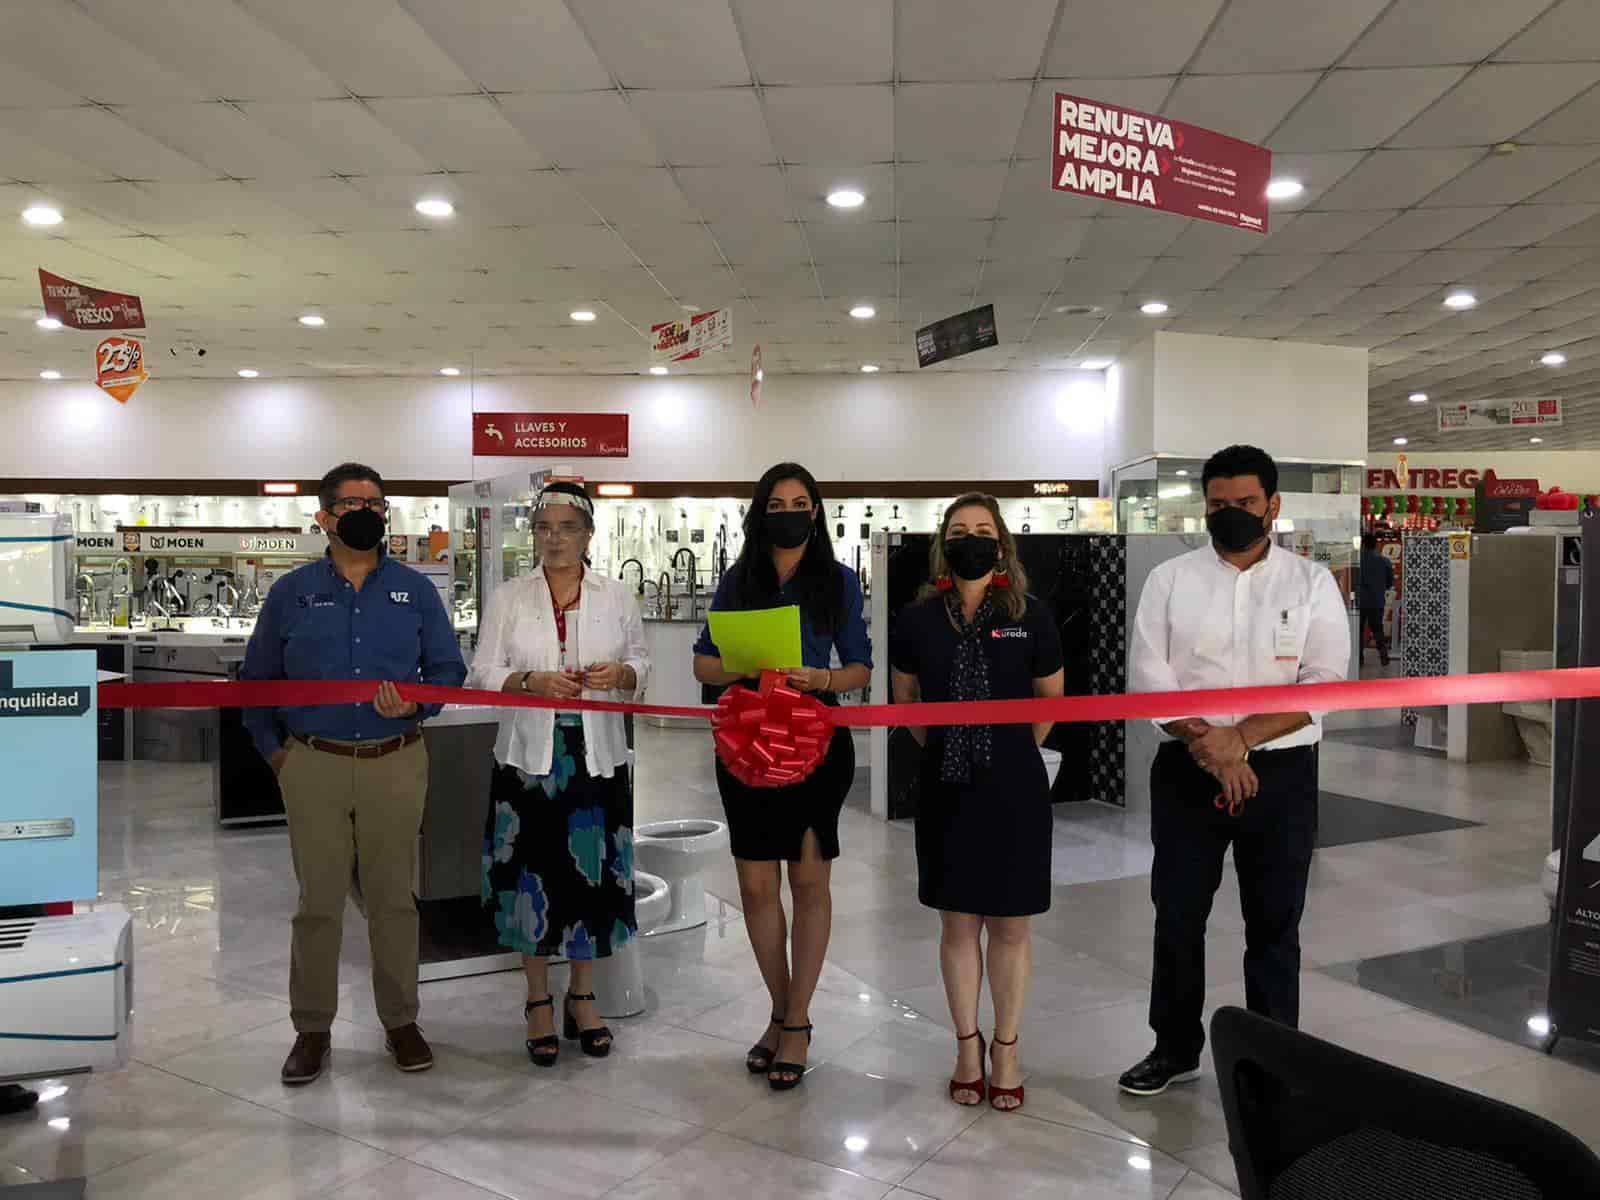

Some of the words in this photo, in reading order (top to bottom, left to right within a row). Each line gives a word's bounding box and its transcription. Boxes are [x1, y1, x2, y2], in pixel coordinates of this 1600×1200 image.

[1060, 99, 1175, 150] RENUEVA
[1059, 129, 1160, 176] MEJORA
[1058, 162, 1156, 205] AMPLIA
[514, 422, 556, 433] LLAVES
[558, 422, 567, 433] Y
[514, 437, 588, 448] ACCESORIOS
[76, 538, 115, 548] MOEN
[167, 538, 204, 548] MOEN
[257, 538, 295, 549] MOEN
